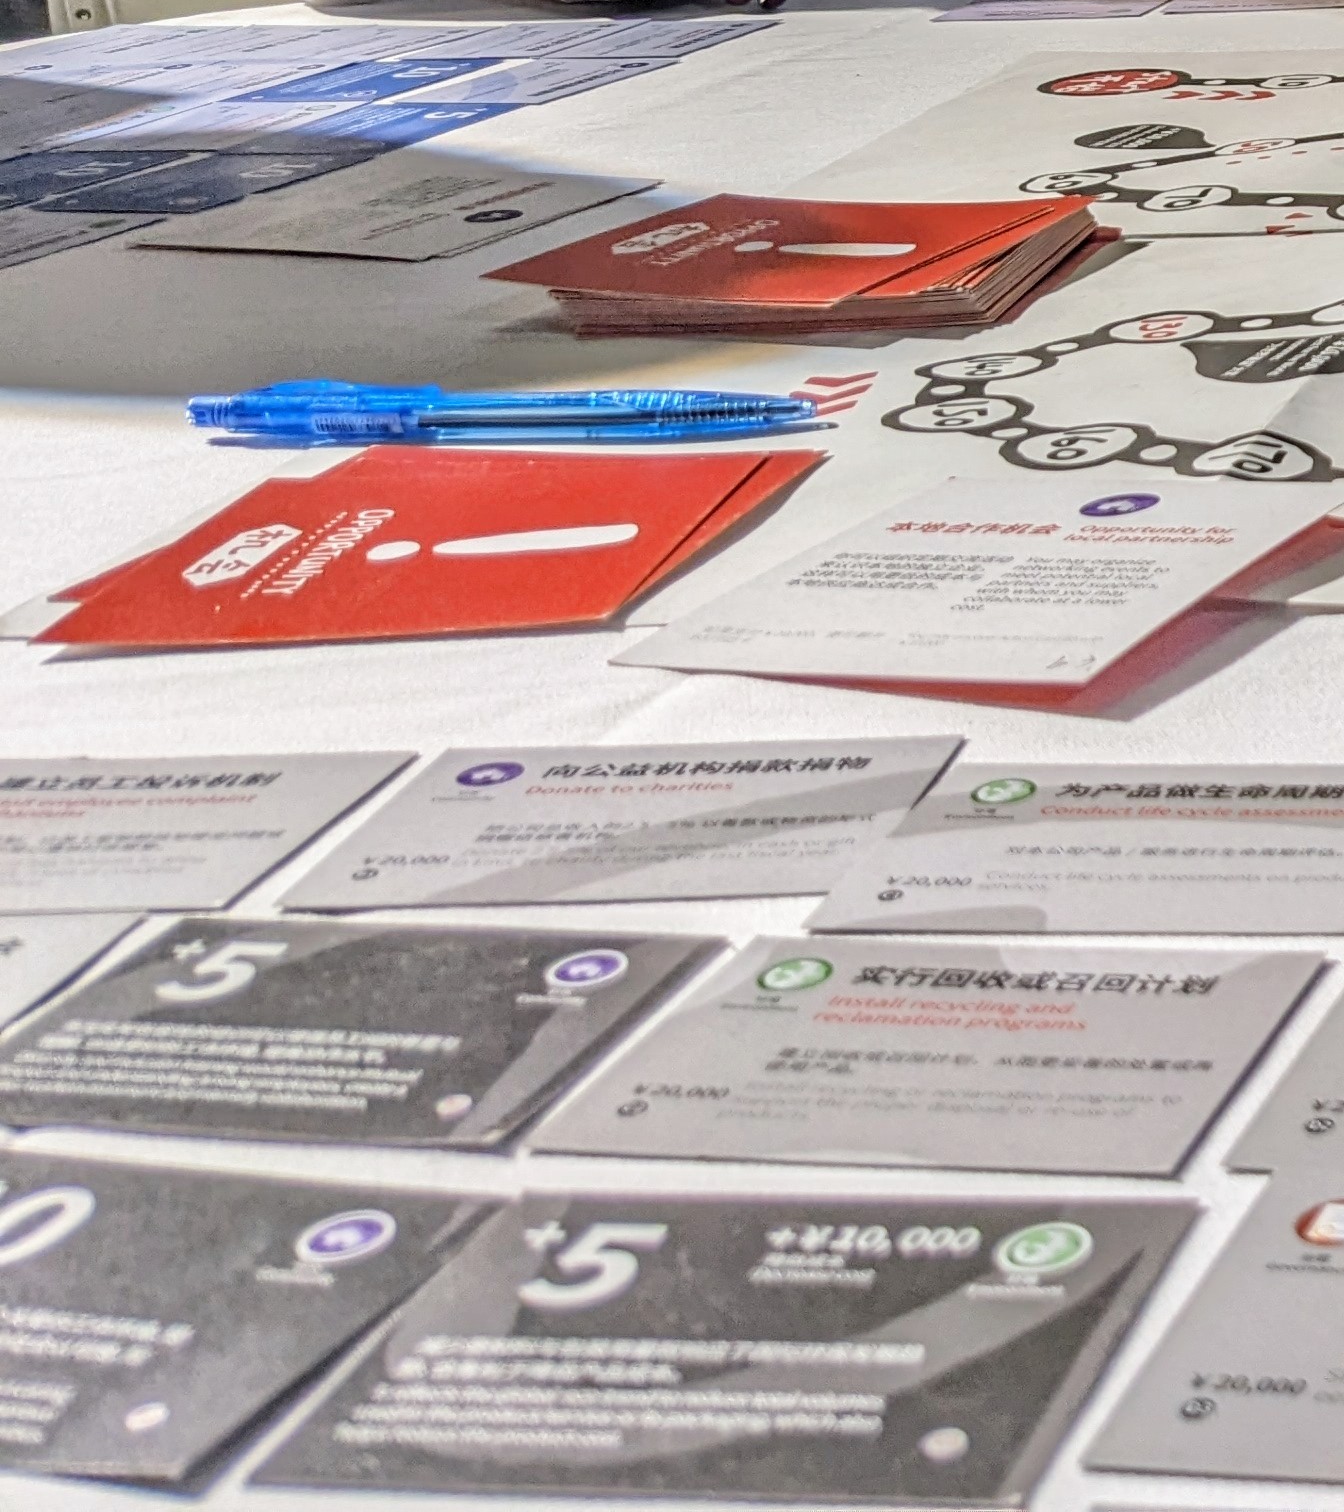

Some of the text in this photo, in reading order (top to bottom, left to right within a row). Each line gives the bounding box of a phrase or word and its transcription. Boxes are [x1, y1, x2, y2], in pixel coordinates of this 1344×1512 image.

[887, 521, 1061, 535] 本地合作机会
[1079, 524, 1236, 536] Opportunity for
[1063, 533, 1233, 544] local partnership
[541, 756, 872, 778] 向公益机构捐款捐物
[525, 784, 605, 794] Donate
[638, 781, 735, 792] charities
[1040, 804, 1132, 816] Conduct
[1176, 806, 1232, 818] cycle
[850, 965, 1221, 995] 实行回收或召回计划
[828, 995, 1075, 1015] Install recycling and
[813, 1011, 1087, 1031] reclamation programs
[519, 1219, 668, 1310] +5
